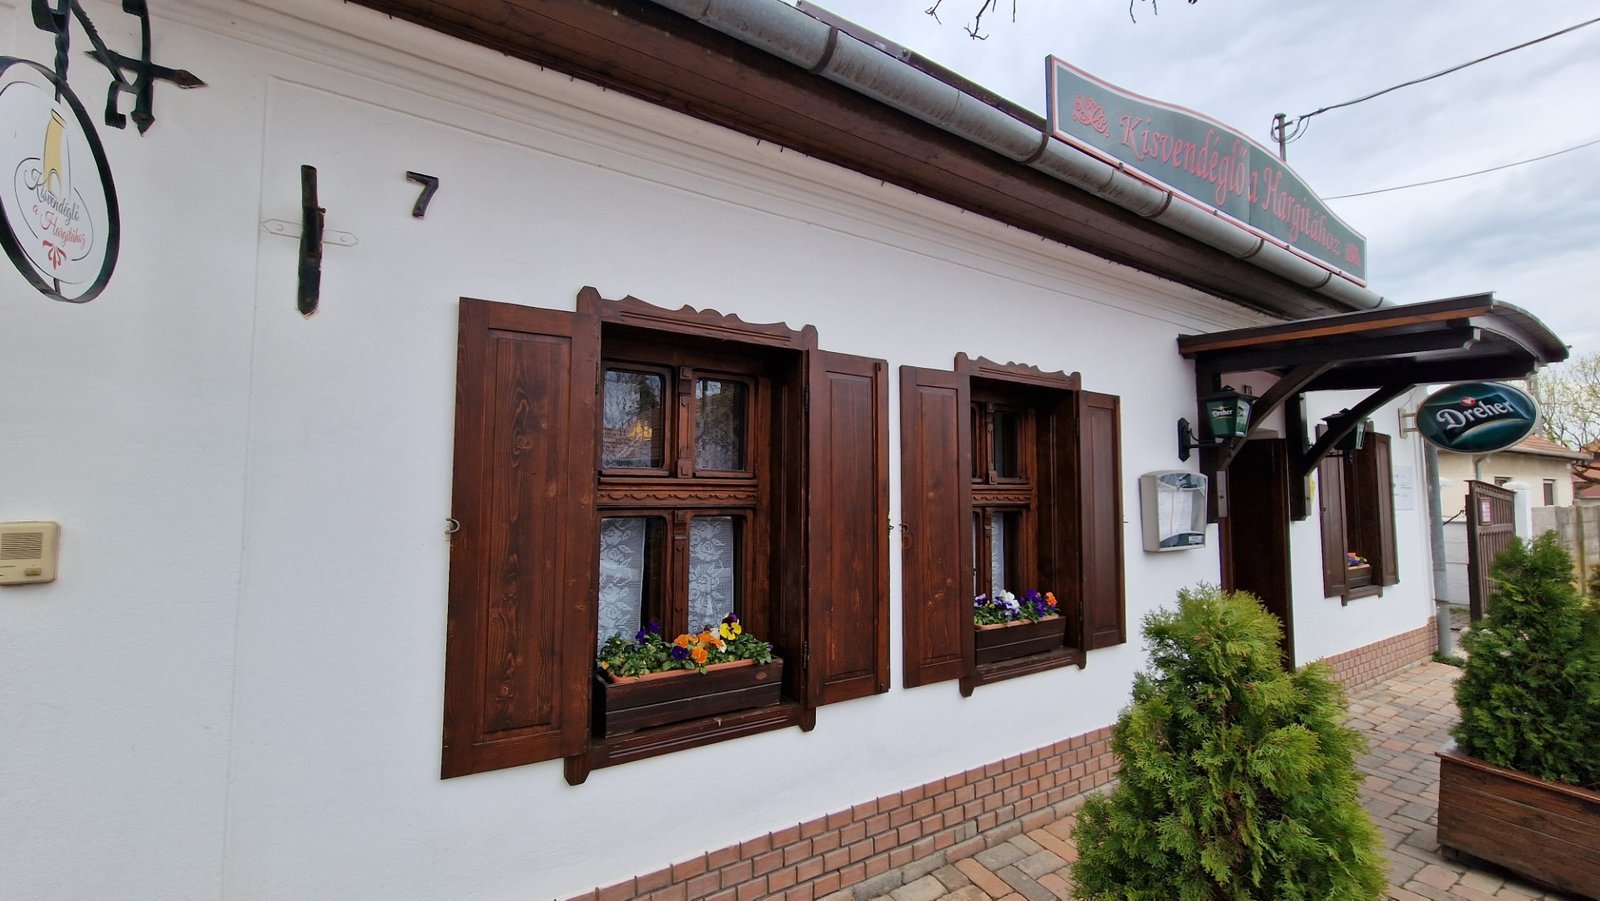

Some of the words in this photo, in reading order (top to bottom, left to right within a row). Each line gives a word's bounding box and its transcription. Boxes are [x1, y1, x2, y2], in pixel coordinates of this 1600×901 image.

[406, 170, 439, 218] 7
[1119, 112, 1247, 206] Kisvendéglő
[1247, 170, 1259, 204] a
[1262, 167, 1341, 257] Hargitához
[1211, 410, 1233, 418] Dreher
[1436, 400, 1515, 430] Dreher
